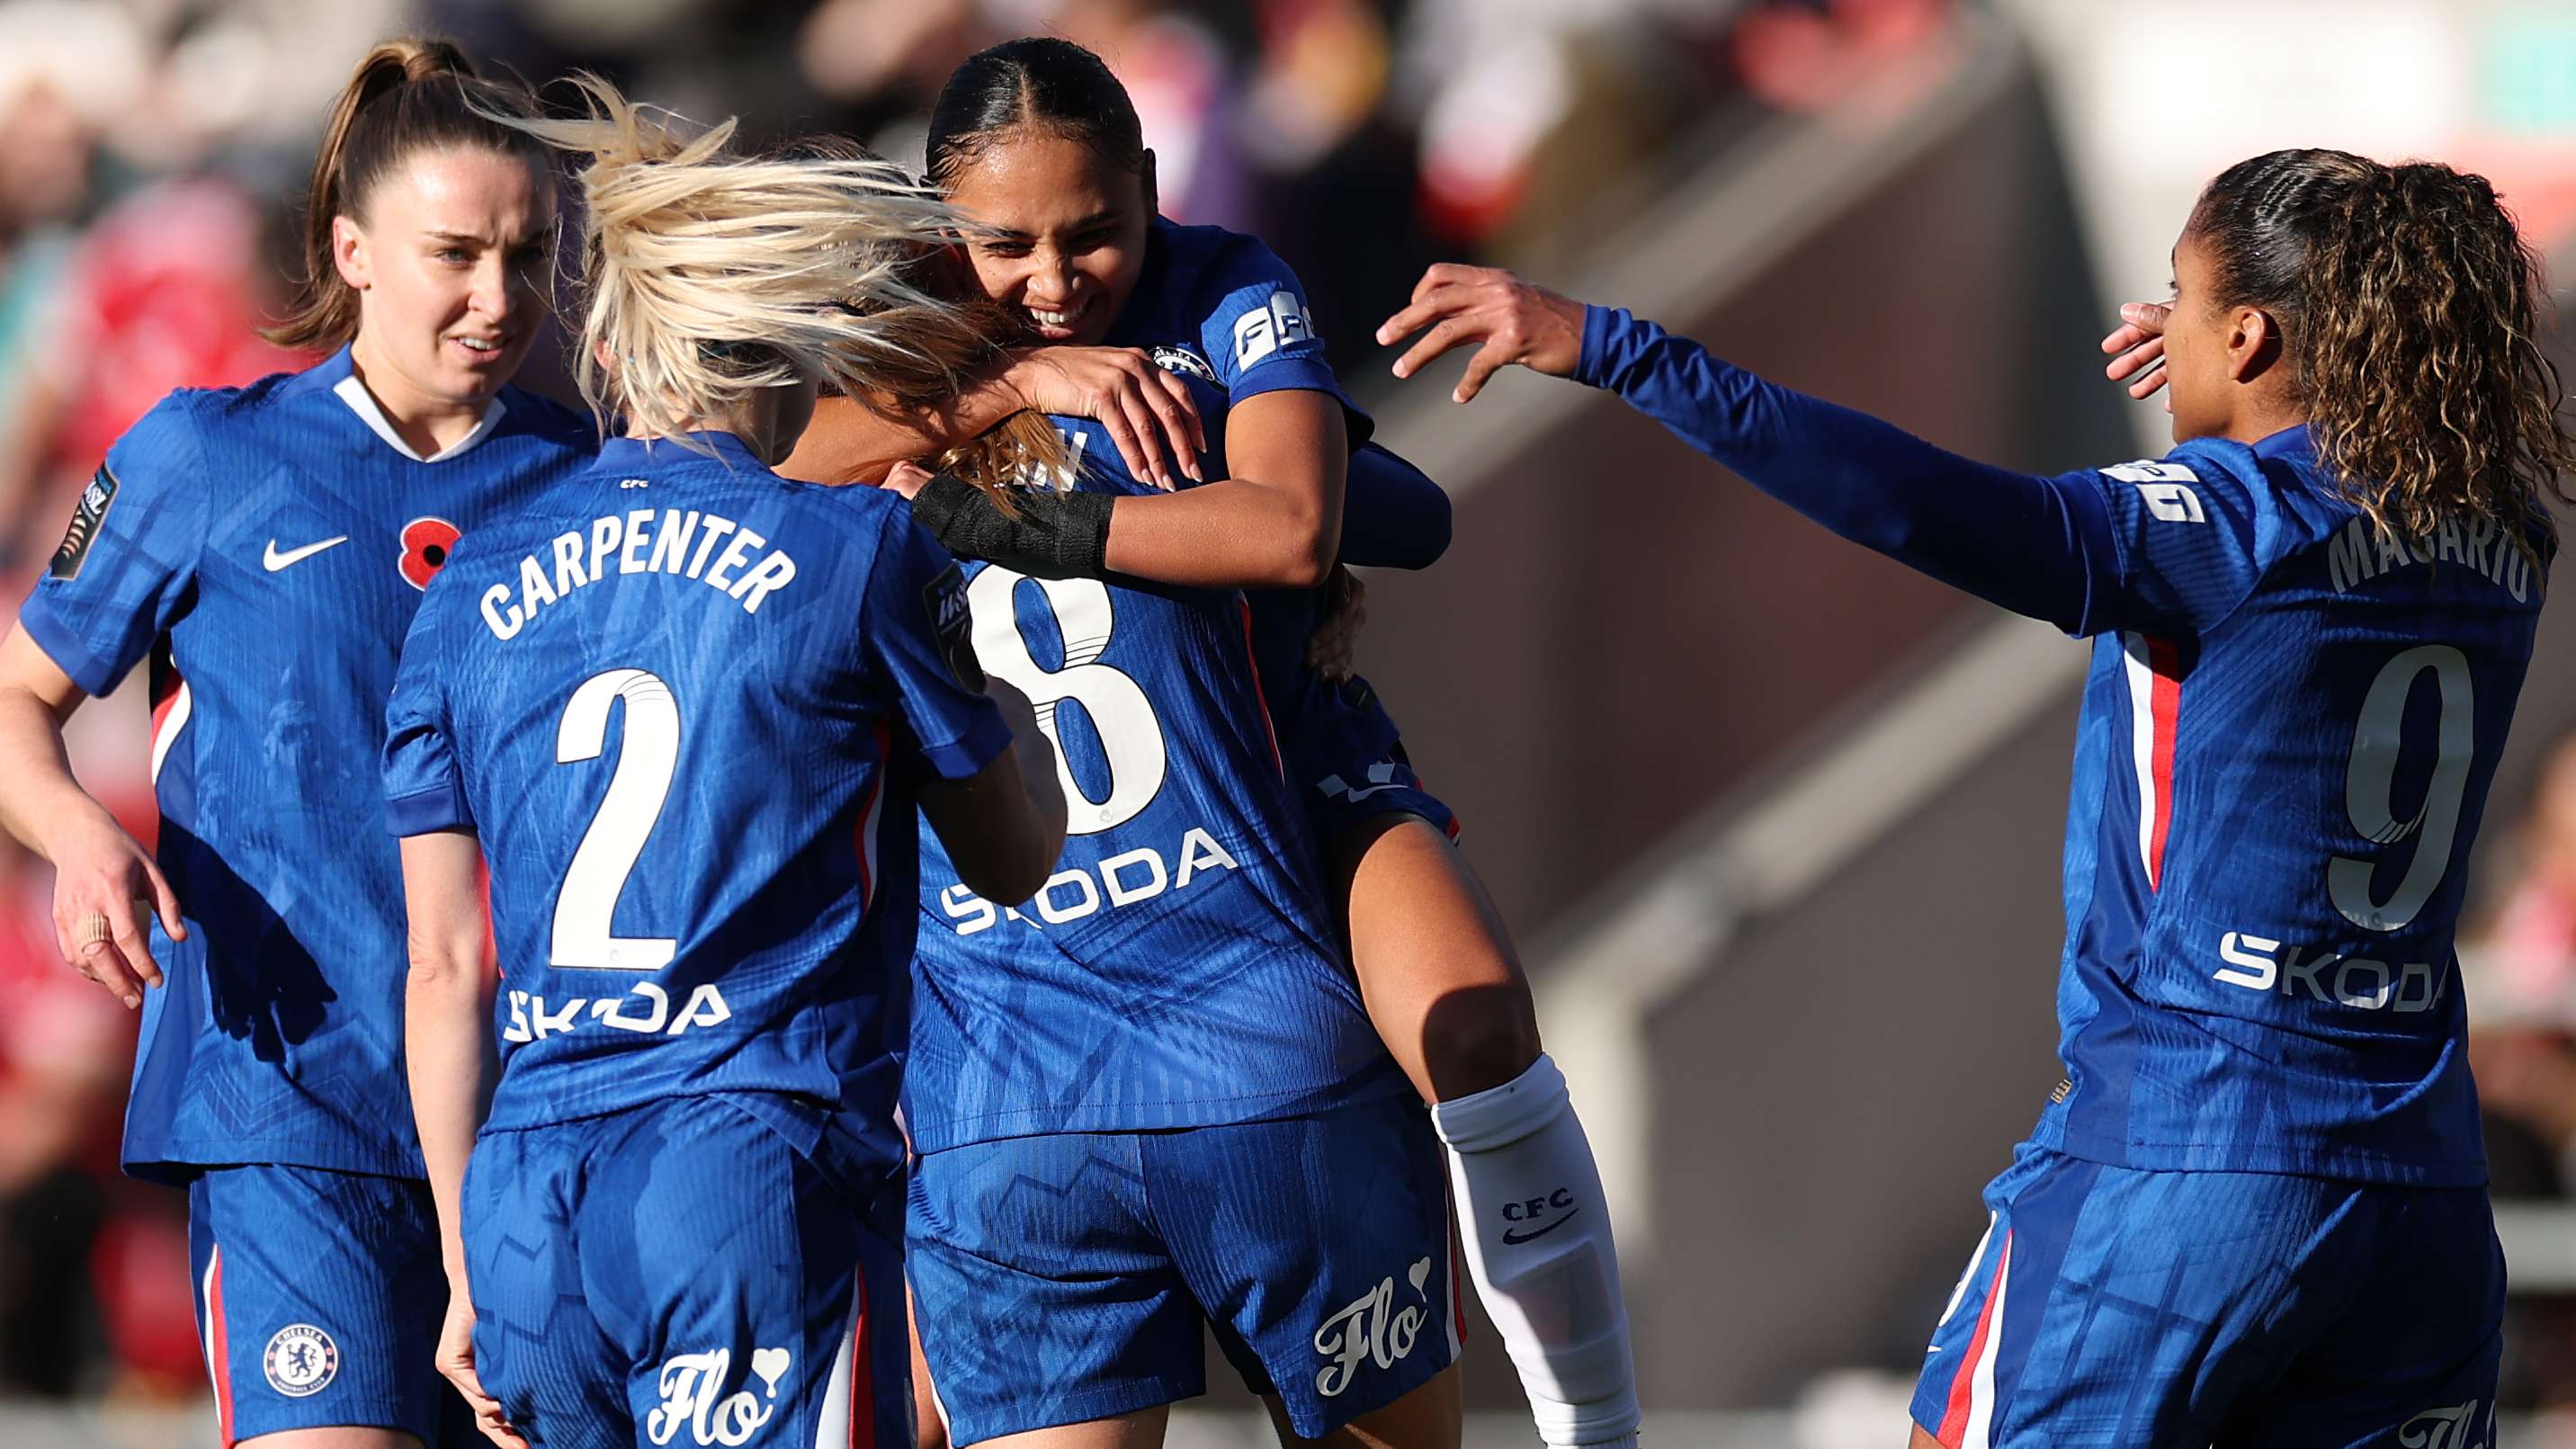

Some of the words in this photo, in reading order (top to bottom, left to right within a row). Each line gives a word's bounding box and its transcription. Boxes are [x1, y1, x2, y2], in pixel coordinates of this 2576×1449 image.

[1234, 291, 1314, 372] FP
[621, 479, 648, 489] CFC
[2097, 459, 2205, 523] PG
[480, 508, 797, 640] CARPENTER
[938, 583, 970, 627] WS
[966, 564, 1167, 836] 8
[549, 667, 680, 971] 2
[2327, 644, 2474, 933] 9
[941, 827, 1239, 936] SODA
[2212, 931, 2451, 1013] SKOD
[1502, 1187, 1573, 1221] CFC
[1313, 1275, 1428, 1398] Flo
[647, 1347, 774, 1446] Flo
